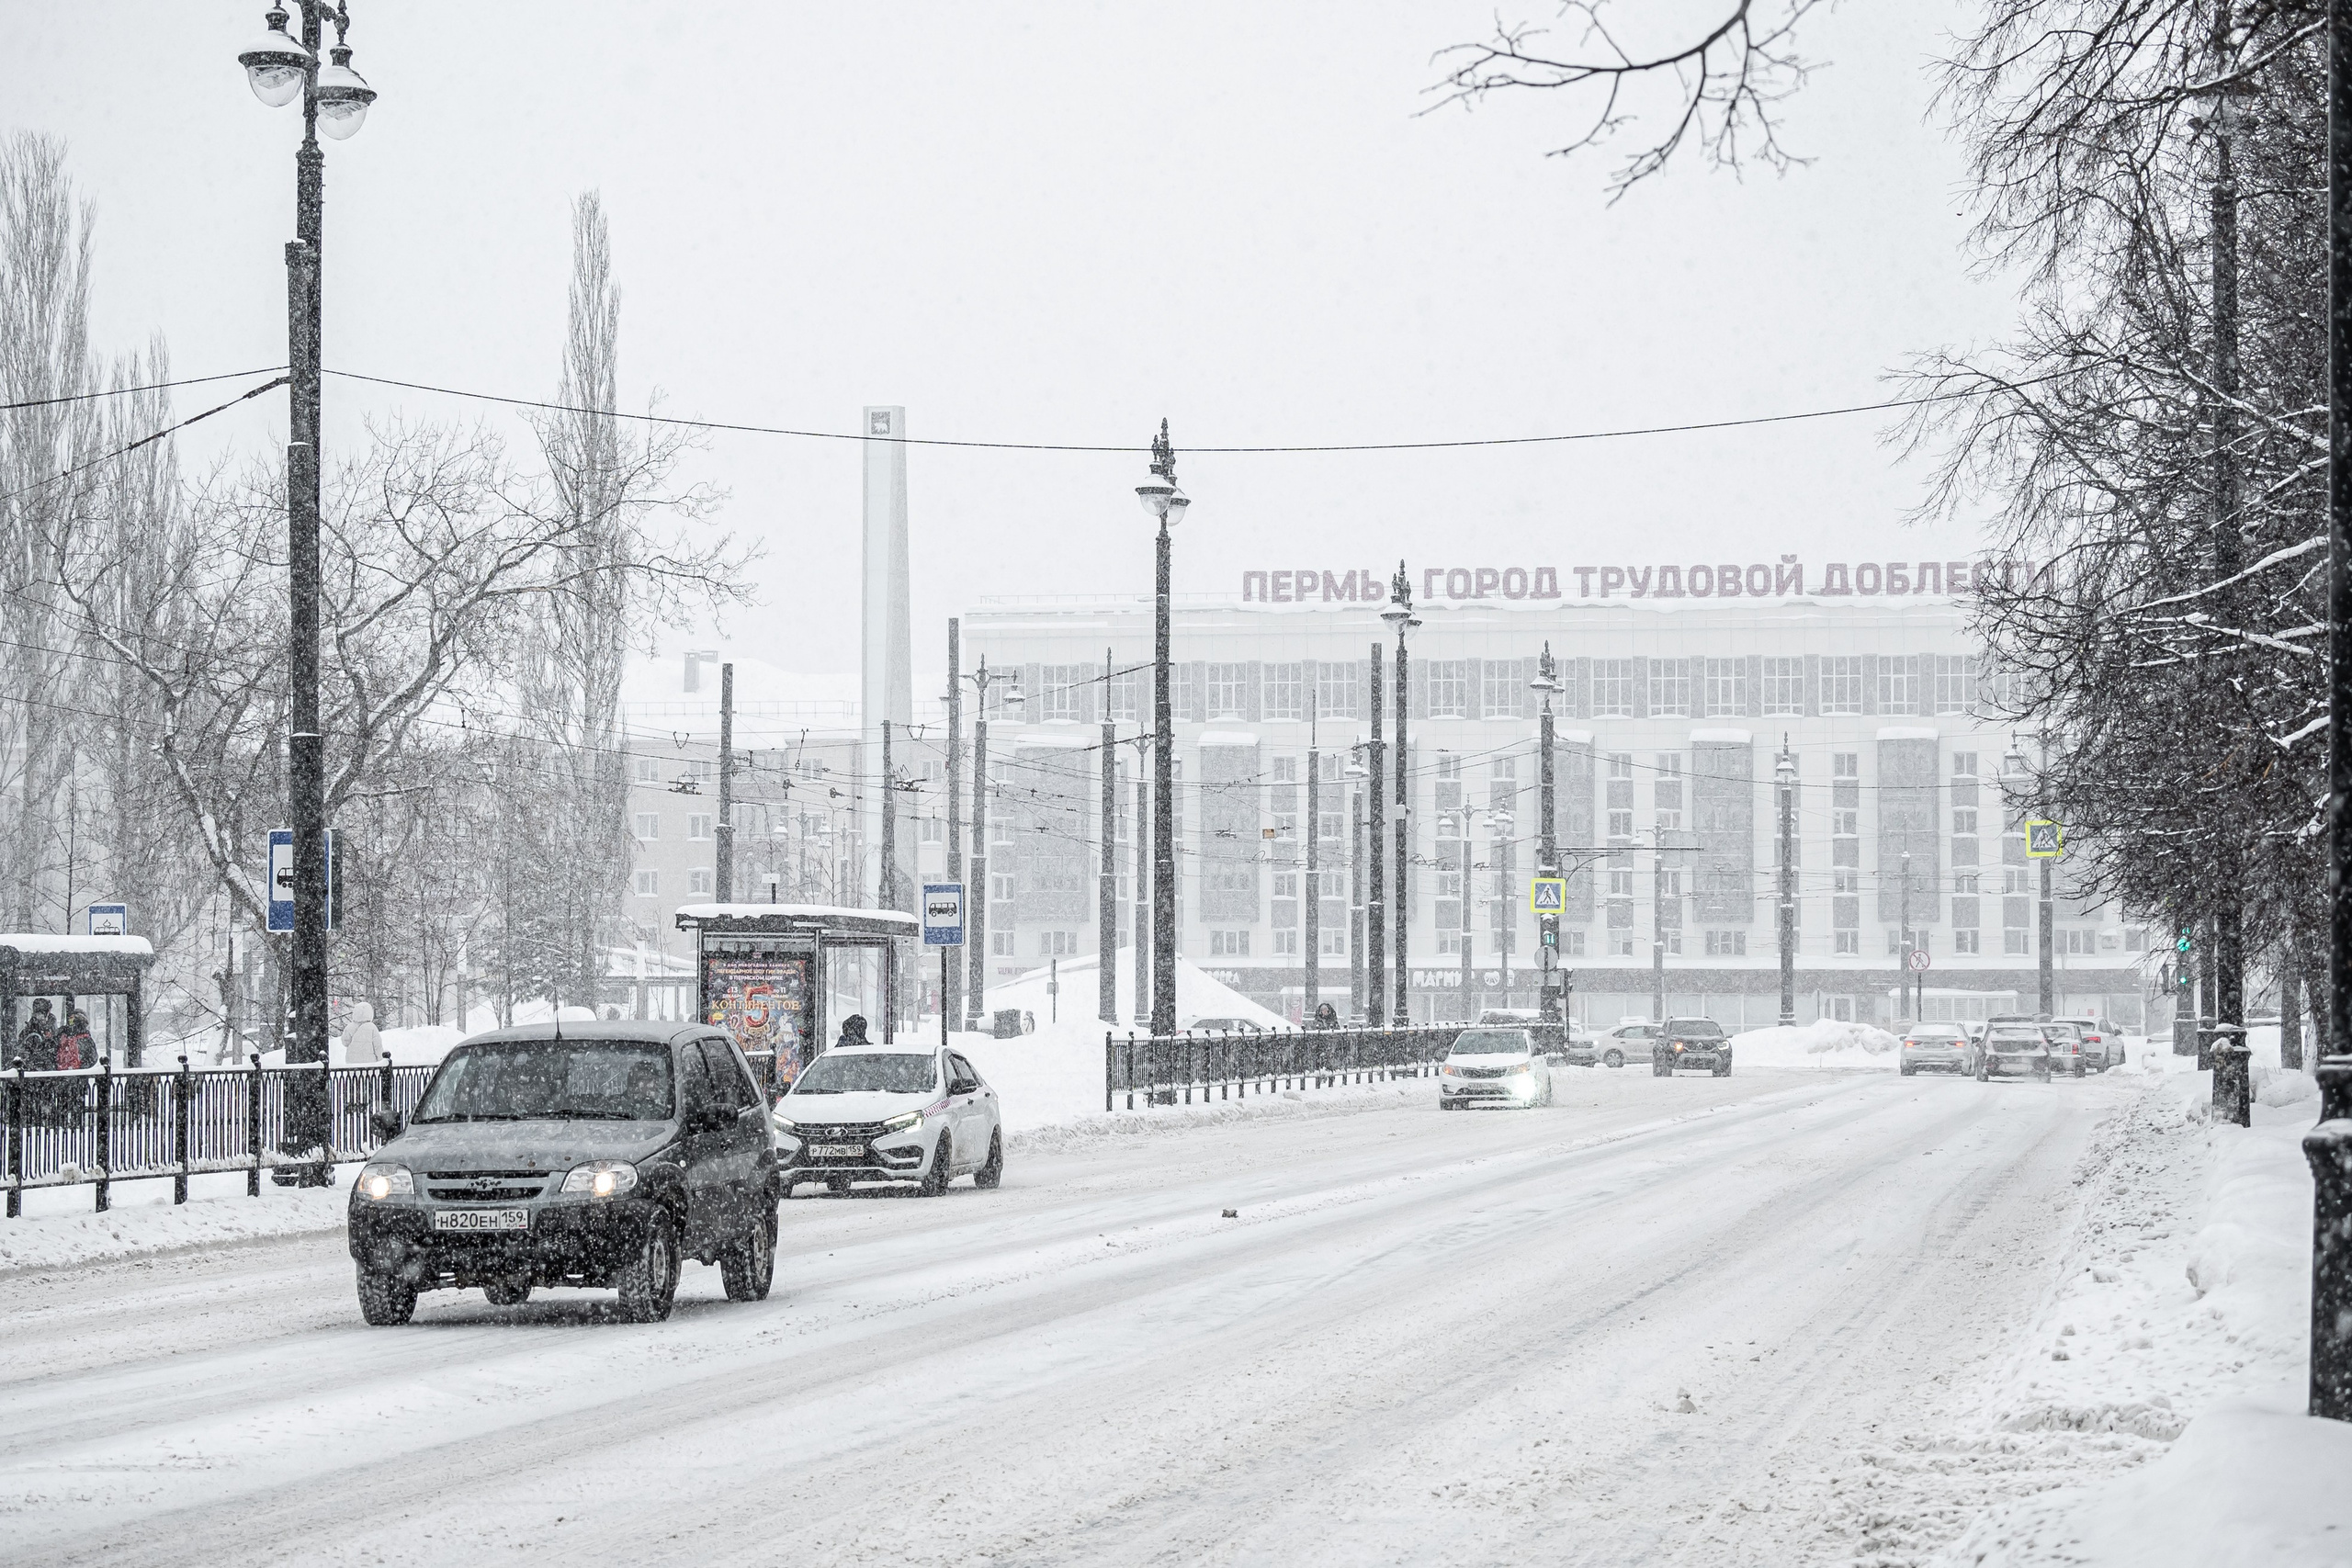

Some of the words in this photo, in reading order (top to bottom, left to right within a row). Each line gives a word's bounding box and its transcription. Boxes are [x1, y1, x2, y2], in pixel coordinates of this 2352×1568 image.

[1243, 570, 1385, 603] ПЕРМЬ
[1424, 567, 1561, 600] ГОРОД
[1573, 554, 1803, 598] ТРУДОВОЙ
[711, 999, 799, 1011] КОНТИНЕНТОВ
[743, 985, 770, 1028] 5
[440, 1213, 498, 1228] Н820ЕН
[501, 1211, 524, 1223] 159
